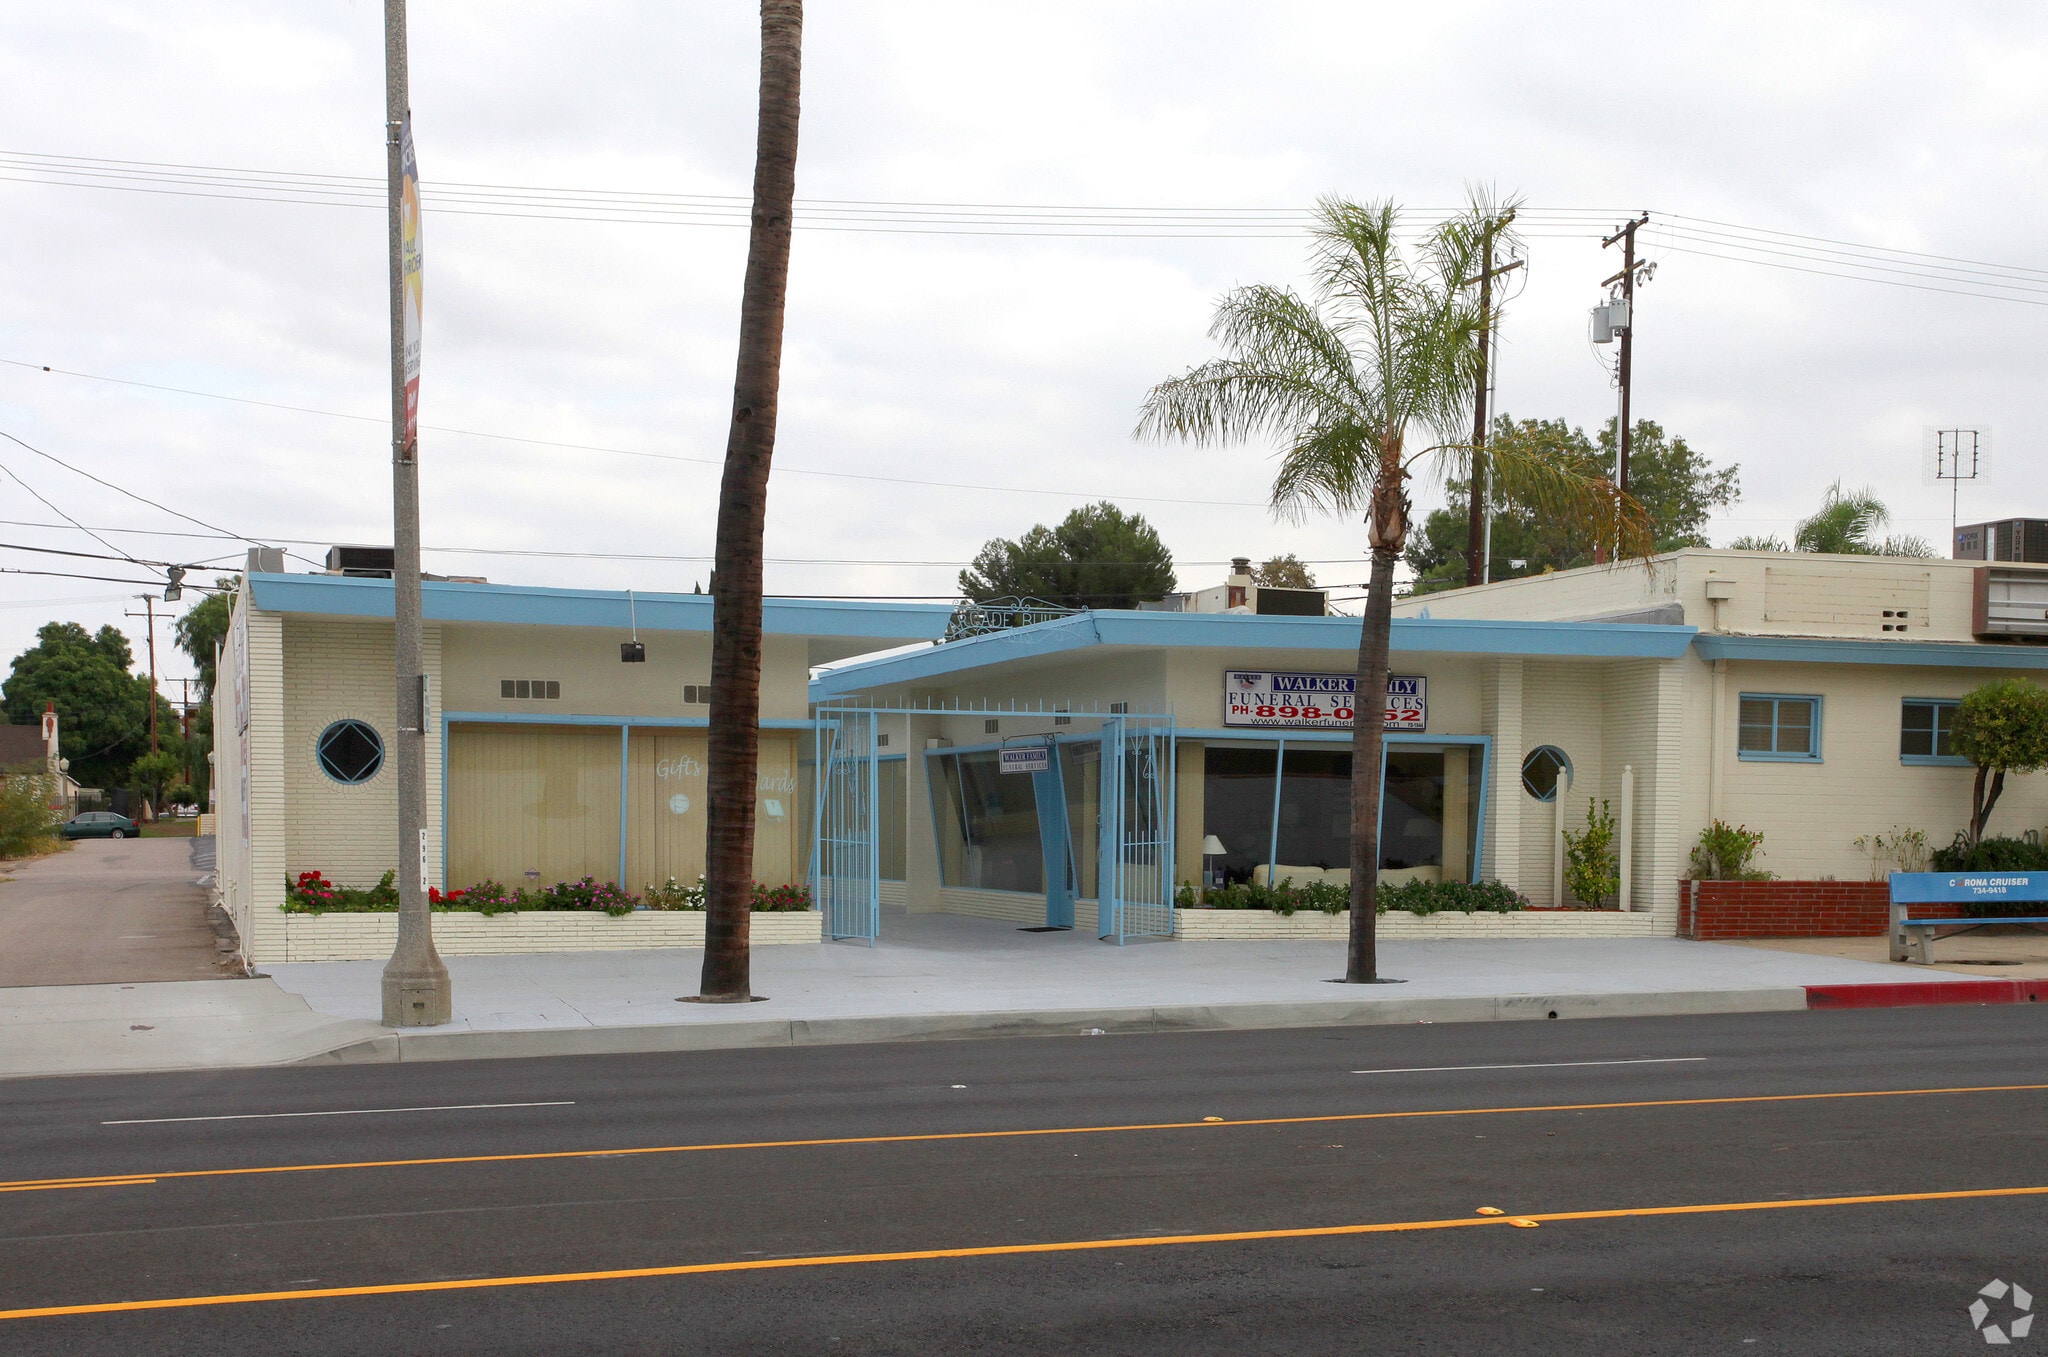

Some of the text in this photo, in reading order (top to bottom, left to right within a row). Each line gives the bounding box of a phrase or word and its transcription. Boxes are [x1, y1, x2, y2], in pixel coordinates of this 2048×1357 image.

[1965, 532, 1979, 541] YORK
[948, 611, 1013, 634] ARCADE
[1277, 677, 1350, 692] WALKER
[1229, 692, 1424, 709] FUNERAL SECES
[1256, 705, 1420, 721] 898-052
[657, 754, 795, 794] Gifts ards
[1989, 878, 2029, 886] CRUISER
